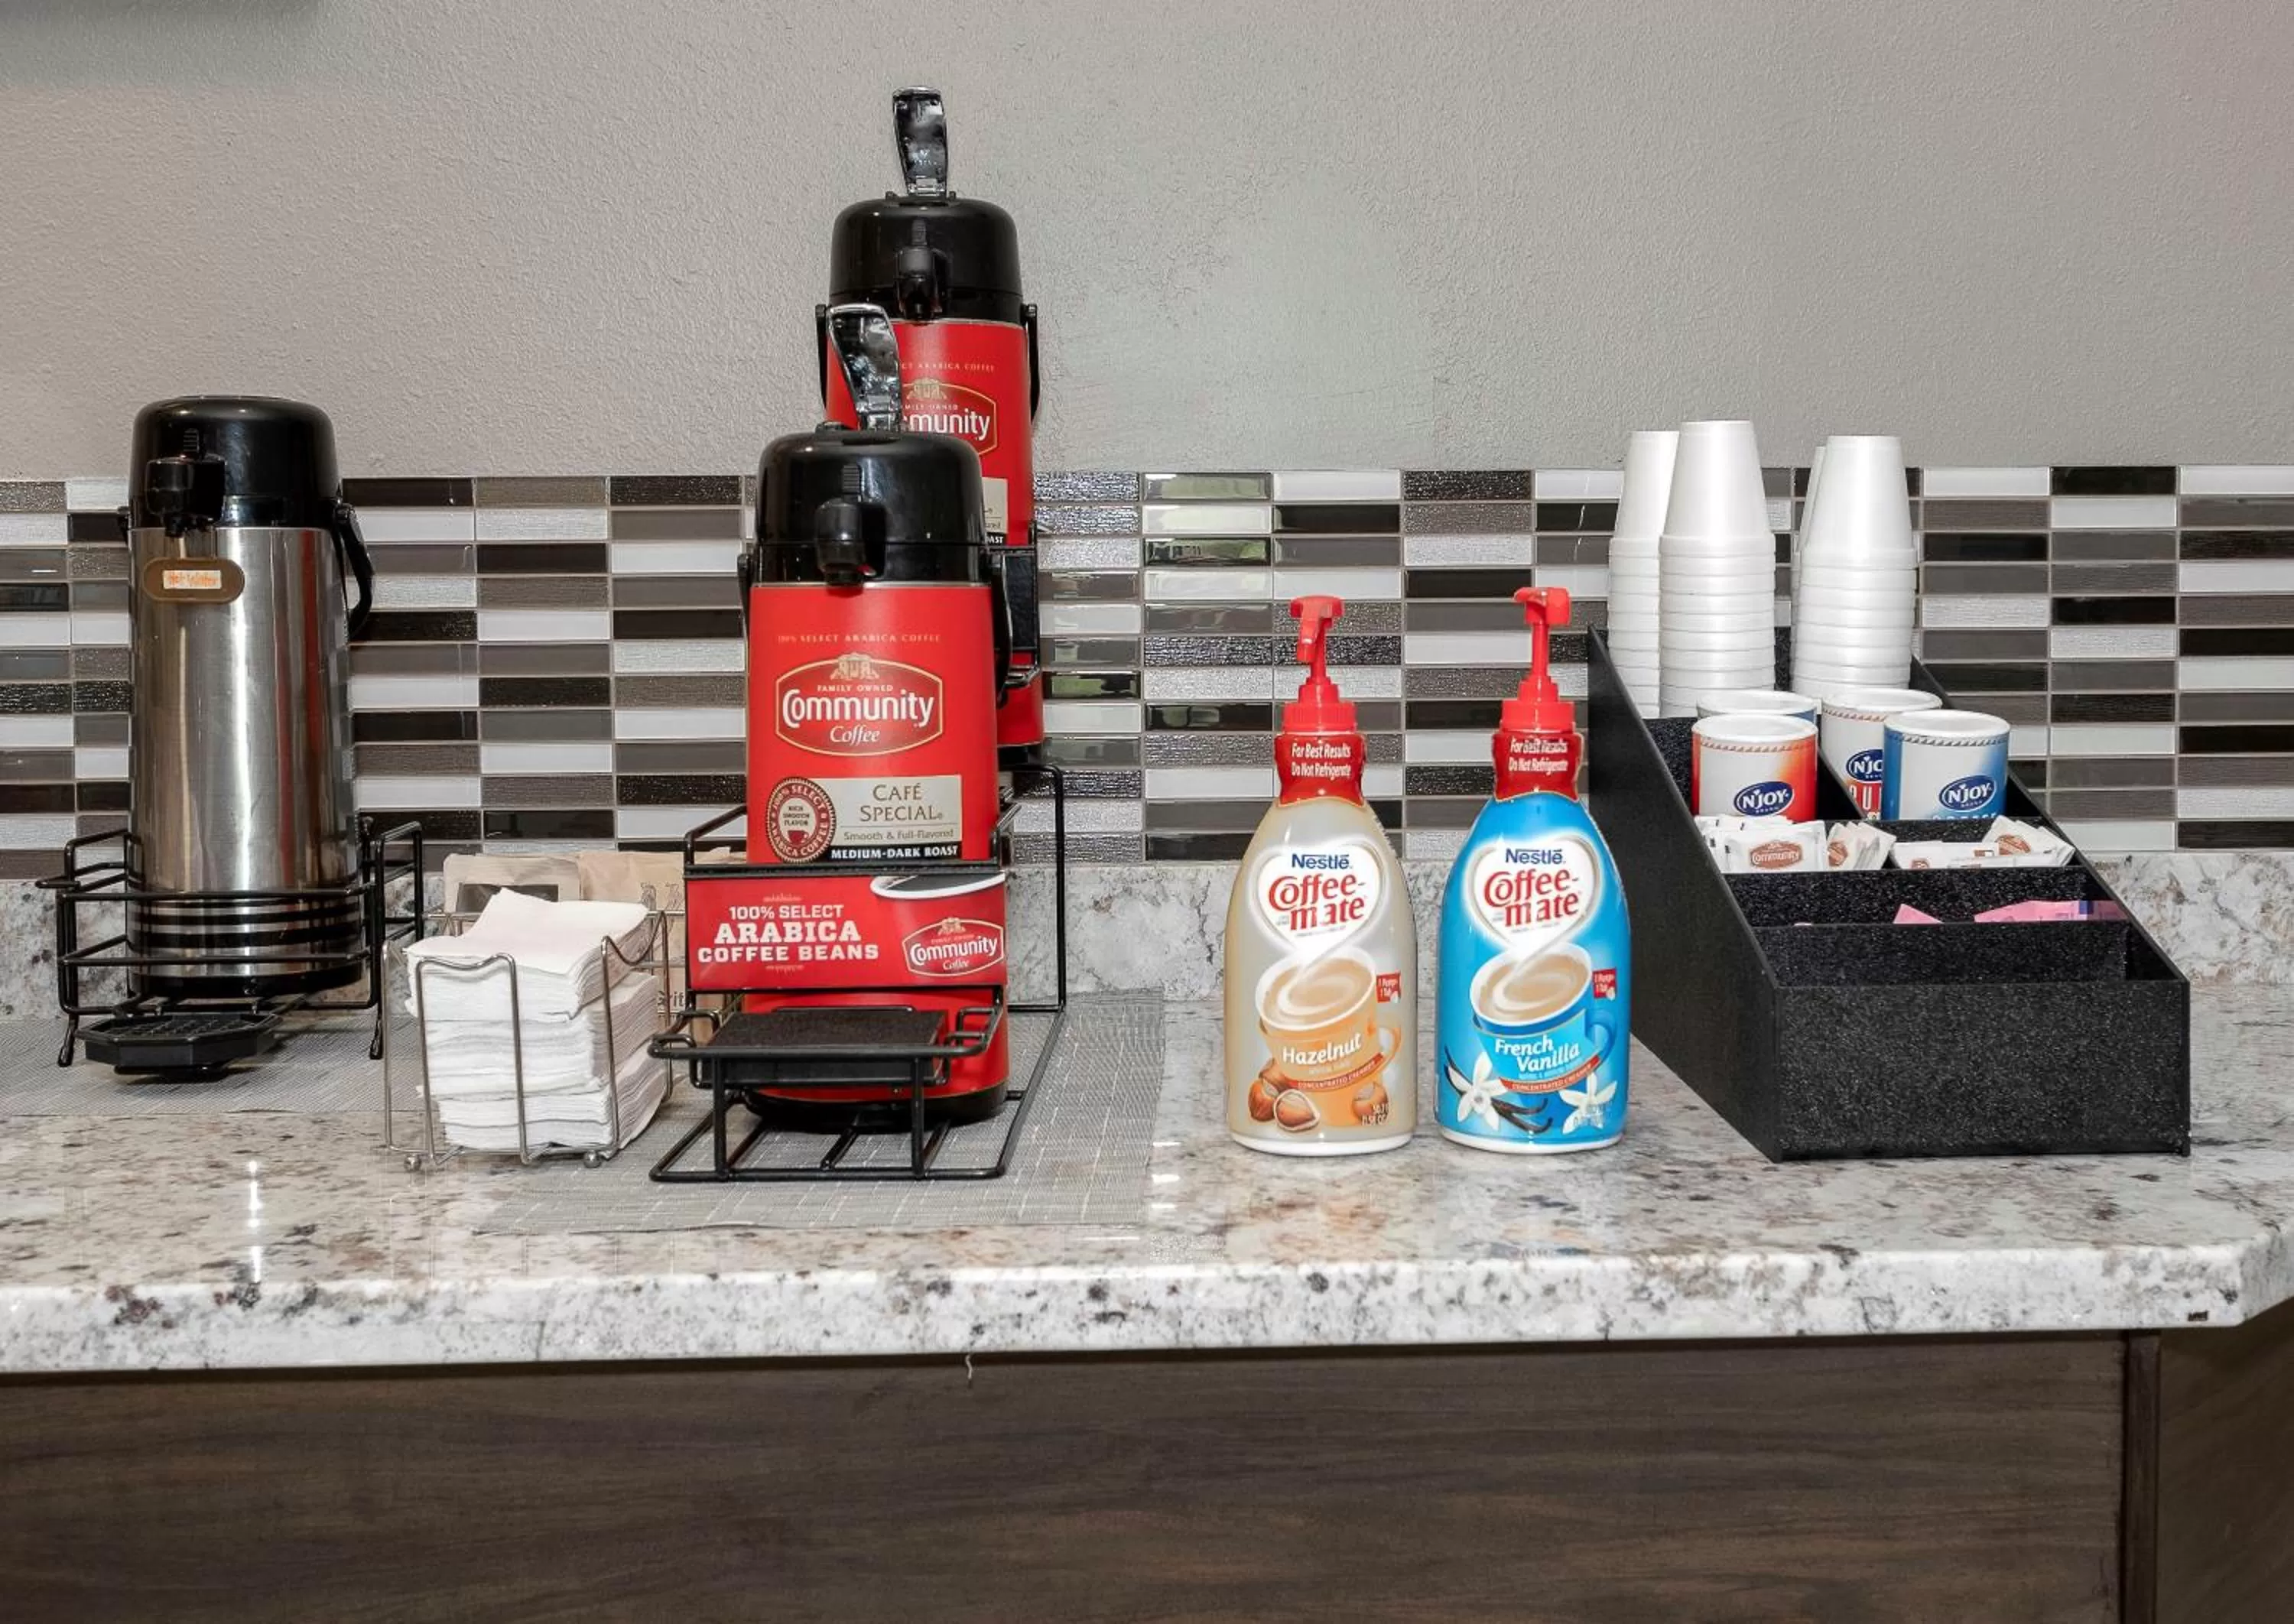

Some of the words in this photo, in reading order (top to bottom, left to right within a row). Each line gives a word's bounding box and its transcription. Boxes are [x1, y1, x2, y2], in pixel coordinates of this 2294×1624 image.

[801, 634, 839, 643] SELECT
[845, 634, 897, 643] ARABICA
[902, 634, 941, 643] COFFEE
[782, 689, 934, 729] Community
[830, 725, 880, 746] Coffee
[1292, 742, 1305, 758] For
[1305, 742, 1323, 758] Best
[1324, 742, 1351, 758] Results
[1291, 762, 1300, 776] Do
[1301, 762, 1314, 777] Not
[1314, 762, 1351, 781] Refrigerate
[791, 784, 826, 810] SELECT
[872, 782, 922, 801] CAFÉ
[843, 831, 883, 841] Smooth
[886, 830, 895, 840] &
[831, 846, 921, 859] MEDIUM-DARK
[924, 845, 958, 857] ROAST
[729, 905, 775, 920] 100%
[778, 905, 844, 918] SELECT
[1290, 897, 1365, 931] mate
[1504, 892, 1579, 927] mate
[713, 920, 861, 944] ARABICA
[697, 946, 788, 963] COFFEE
[798, 944, 879, 961] BEANS
[910, 935, 997, 966] Community
[1282, 1032, 1361, 1064] Hazelnut
[1495, 1034, 1554, 1056] French
[1516, 1042, 1581, 1072] Vanilla
